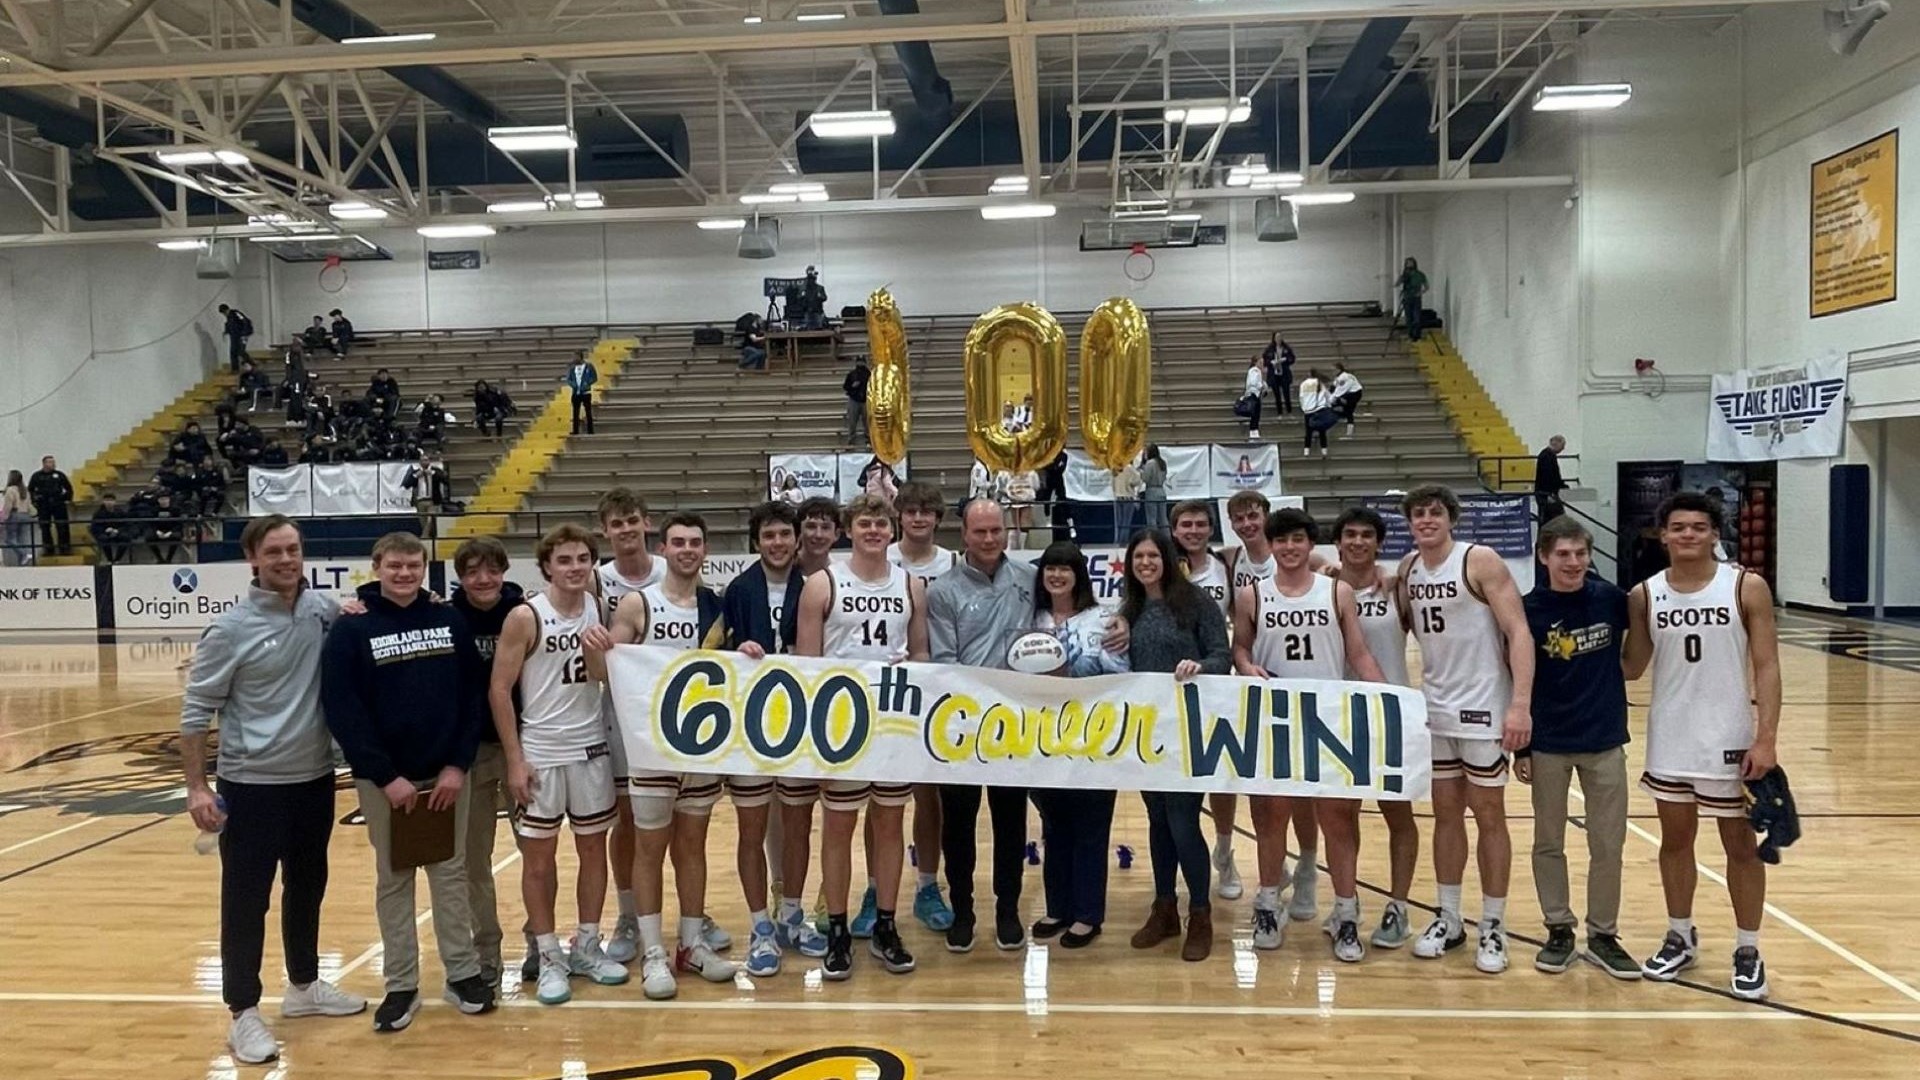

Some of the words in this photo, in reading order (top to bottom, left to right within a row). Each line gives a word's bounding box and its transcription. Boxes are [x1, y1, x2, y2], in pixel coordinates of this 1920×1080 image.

[1771, 380, 1826, 413] FLIGHT
[702, 560, 745, 575] ENNY
[22, 588, 39, 600] OF
[46, 587, 92, 600] TEXAS
[1409, 581, 1457, 600] SCOTS
[127, 596, 190, 620] Origin
[197, 595, 239, 615] Ban
[842, 596, 904, 614] SCOTS
[1265, 608, 1329, 628] SCOTS
[1421, 606, 1445, 633] 15
[1657, 606, 1730, 629] SCOTS
[370, 629, 422, 650] HIGHLAND
[422, 626, 453, 640] PARK
[654, 621, 697, 640] SCO
[861, 618, 888, 646] 14
[372, 644, 401, 660] SCOTS
[400, 638, 455, 654] BASKETBALL
[545, 632, 581, 653] SCO
[1285, 633, 1314, 661] 21
[1684, 633, 1702, 664] 0
[562, 656, 587, 684] 12
